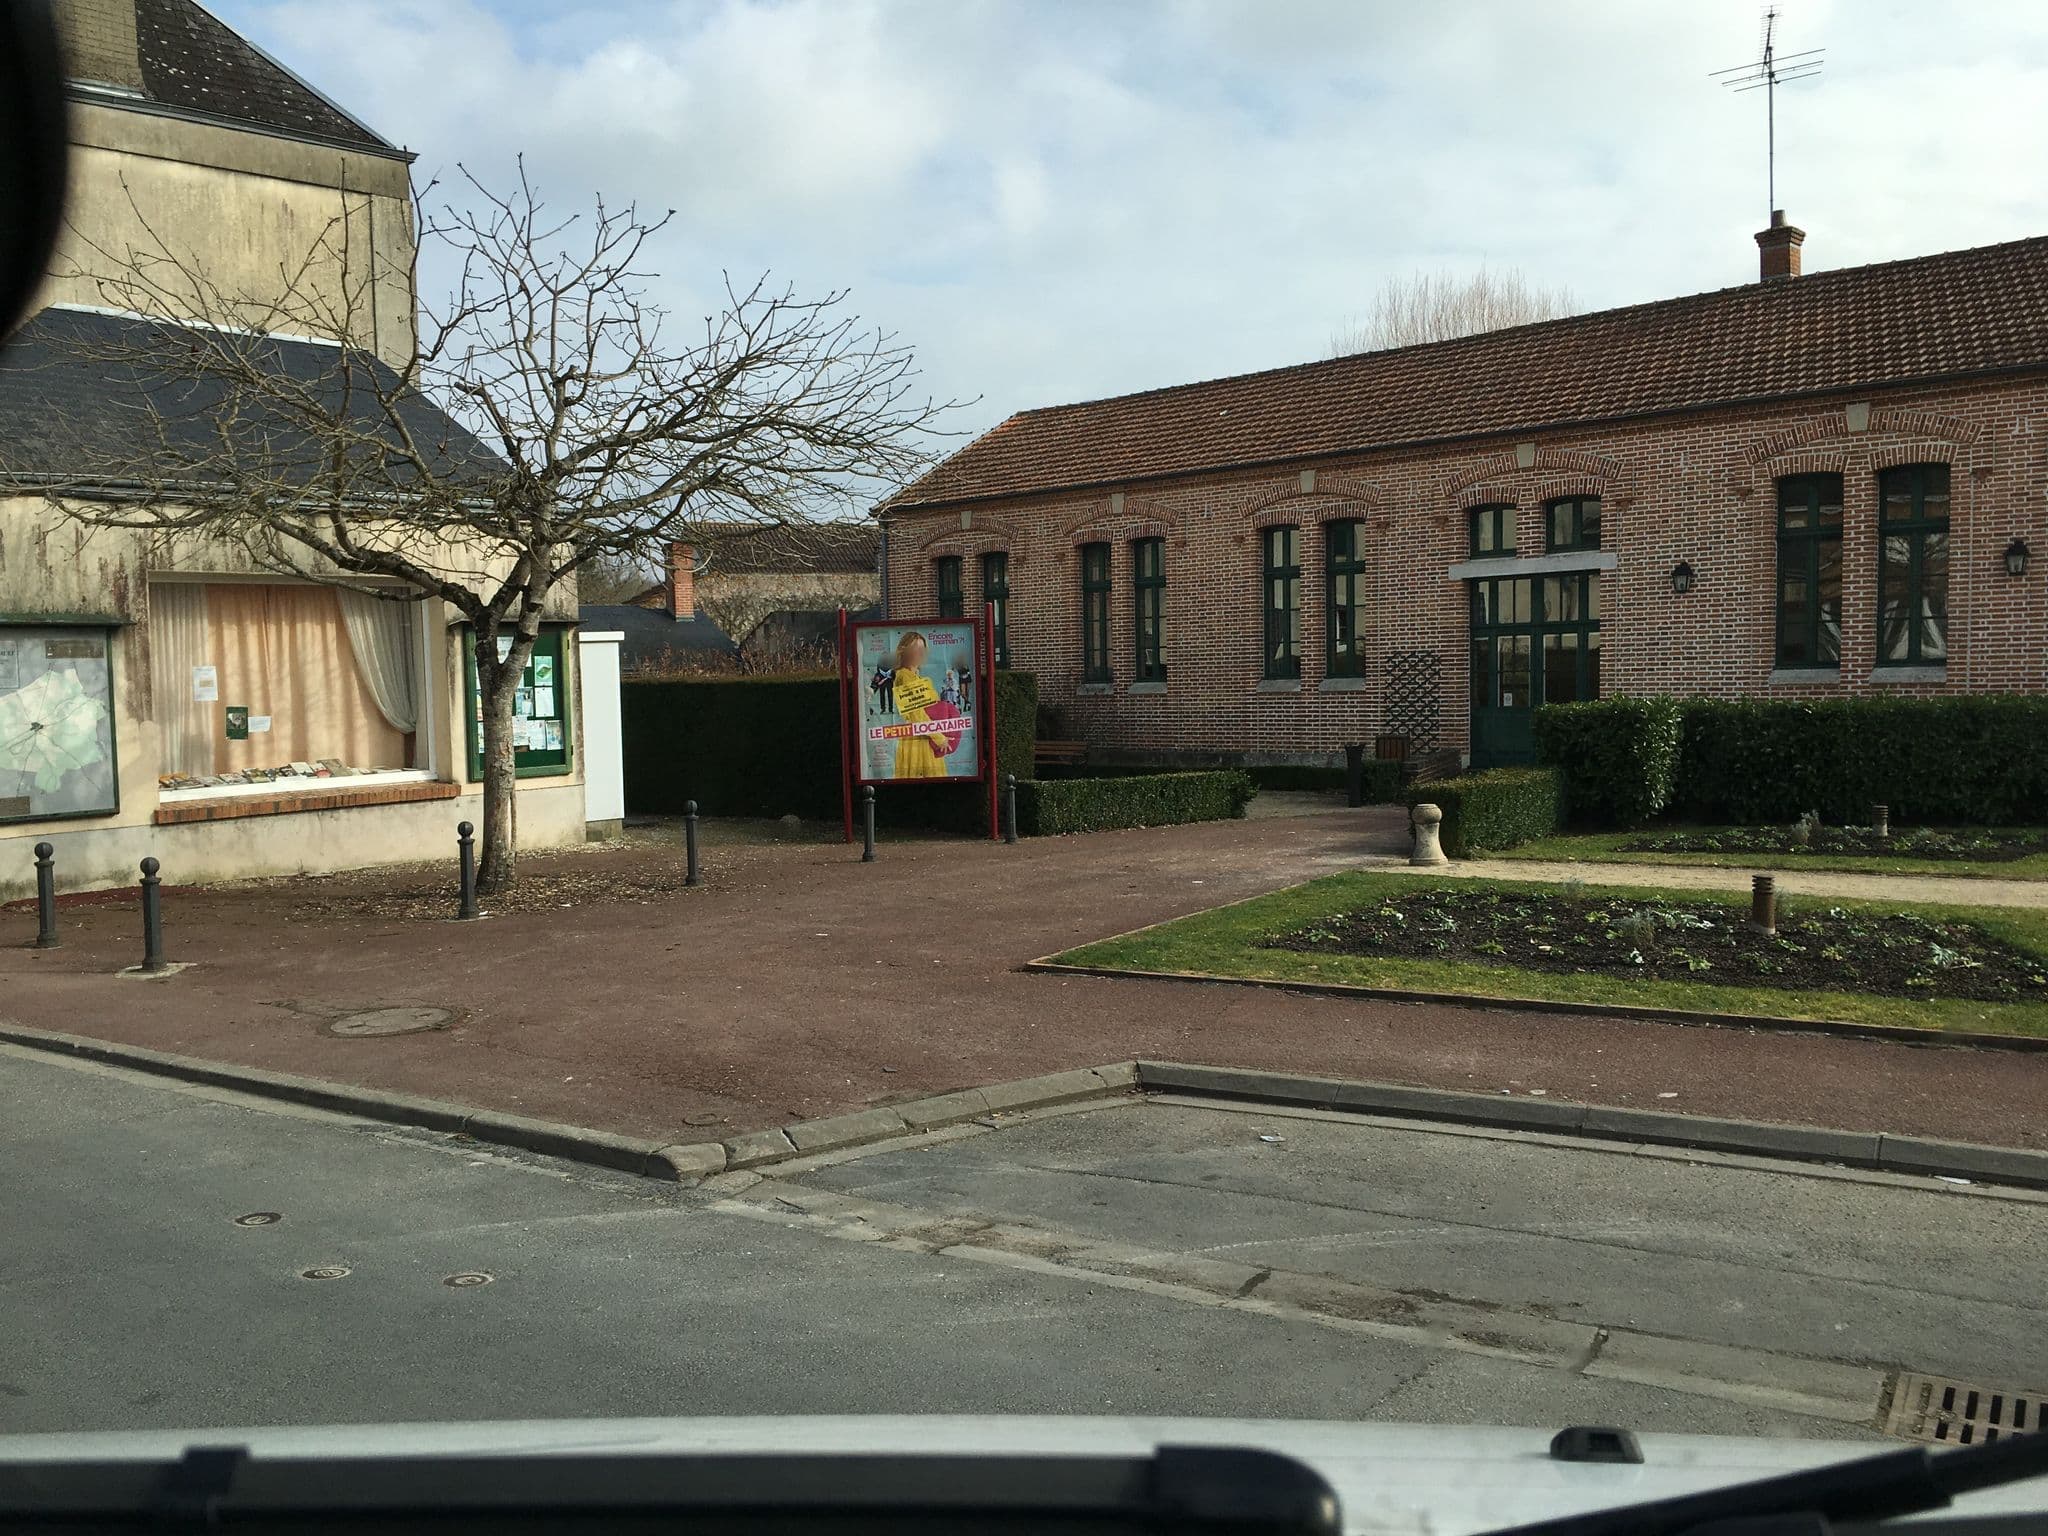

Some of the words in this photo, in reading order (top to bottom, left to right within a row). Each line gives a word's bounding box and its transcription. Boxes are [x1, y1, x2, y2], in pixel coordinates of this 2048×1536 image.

[928, 632, 953, 641] Encore
[870, 728, 882, 739] LE
[884, 725, 912, 738] PETIT
[914, 718, 971, 734] LOCATAIRE
